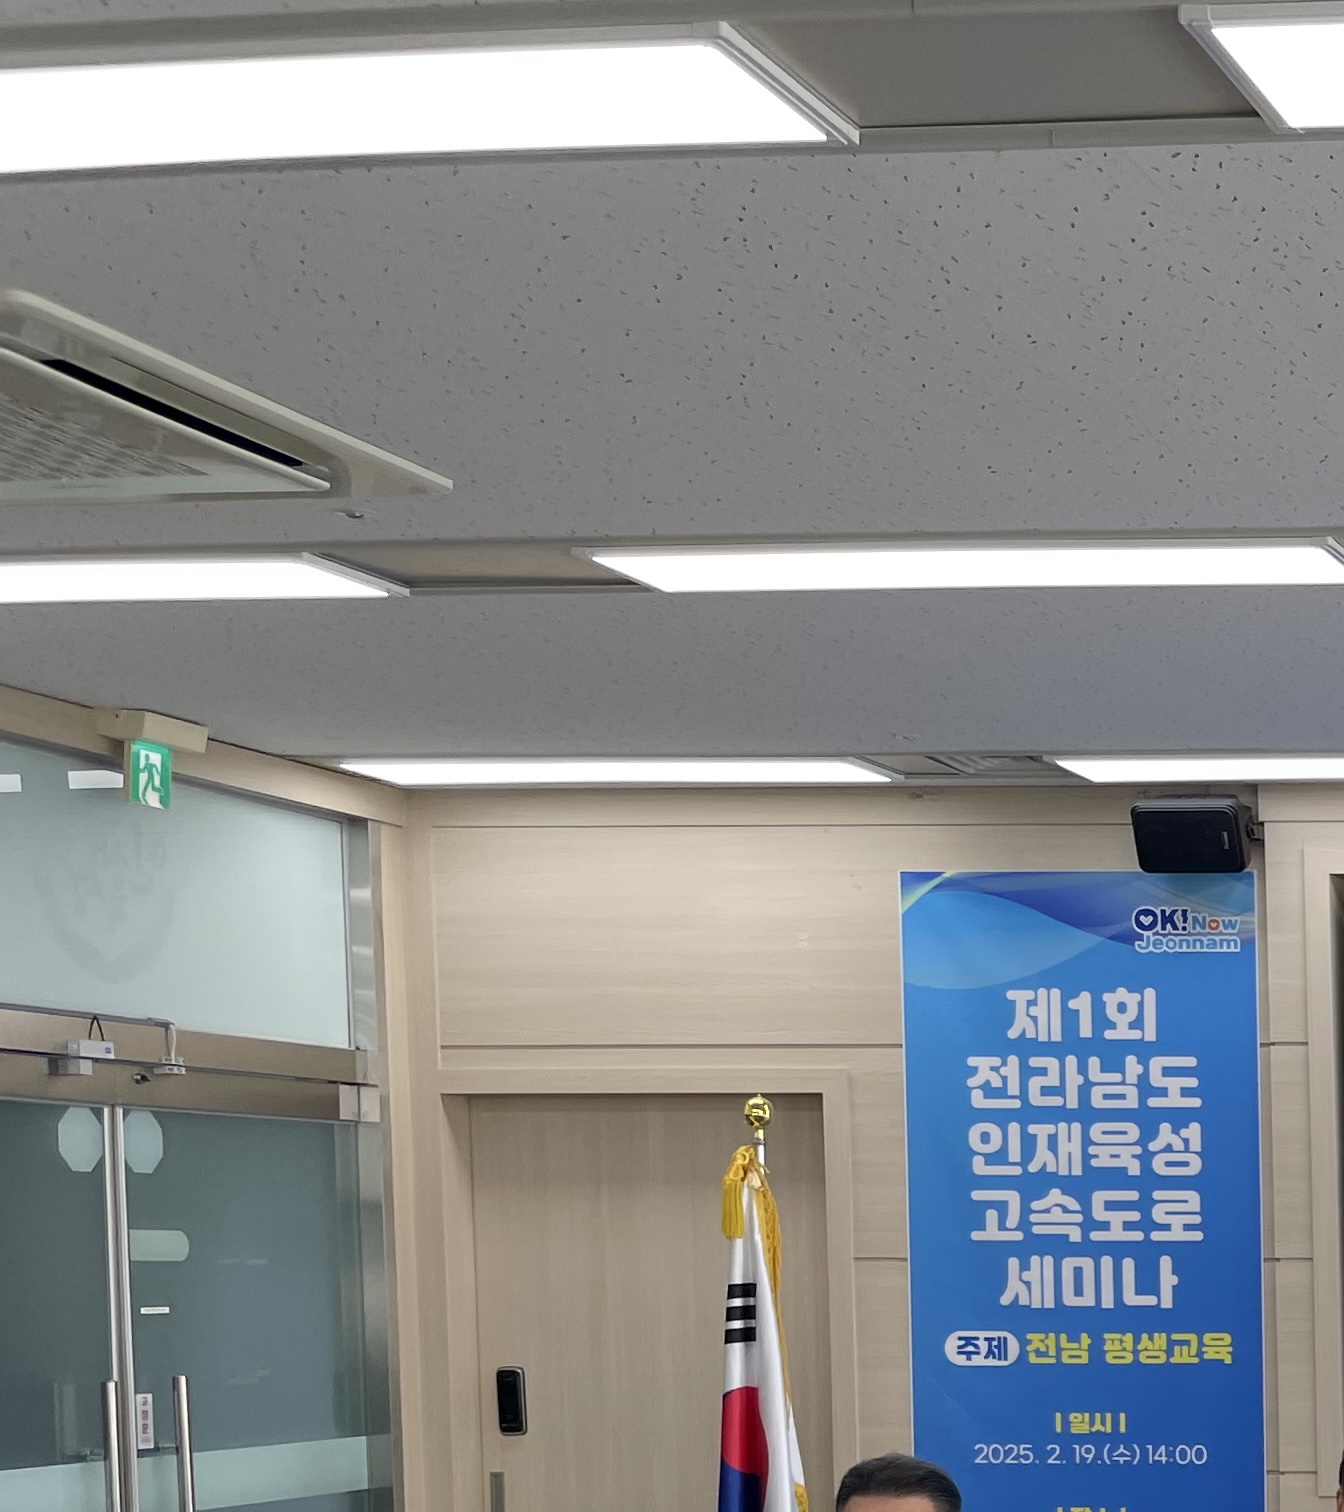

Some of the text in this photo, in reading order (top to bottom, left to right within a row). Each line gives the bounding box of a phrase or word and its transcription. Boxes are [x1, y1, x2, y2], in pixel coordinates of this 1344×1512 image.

[1133, 907, 1239, 932] OK! Now
[1136, 934, 1240, 951] Jeonnam
[1006, 987, 1157, 1042] 제1회
[966, 1054, 1203, 1109] 전라남도
[968, 1121, 1204, 1176] 인재육성
[970, 1187, 1204, 1243] 고속도로
[999, 1255, 1179, 1309] 세미나
[956, 1332, 1233, 1365] 주제 전남 평생교육
[1069, 1412, 1112, 1434] 일시
[974, 1442, 1208, 1467] 2025. 2. 19.(수) 14:00
